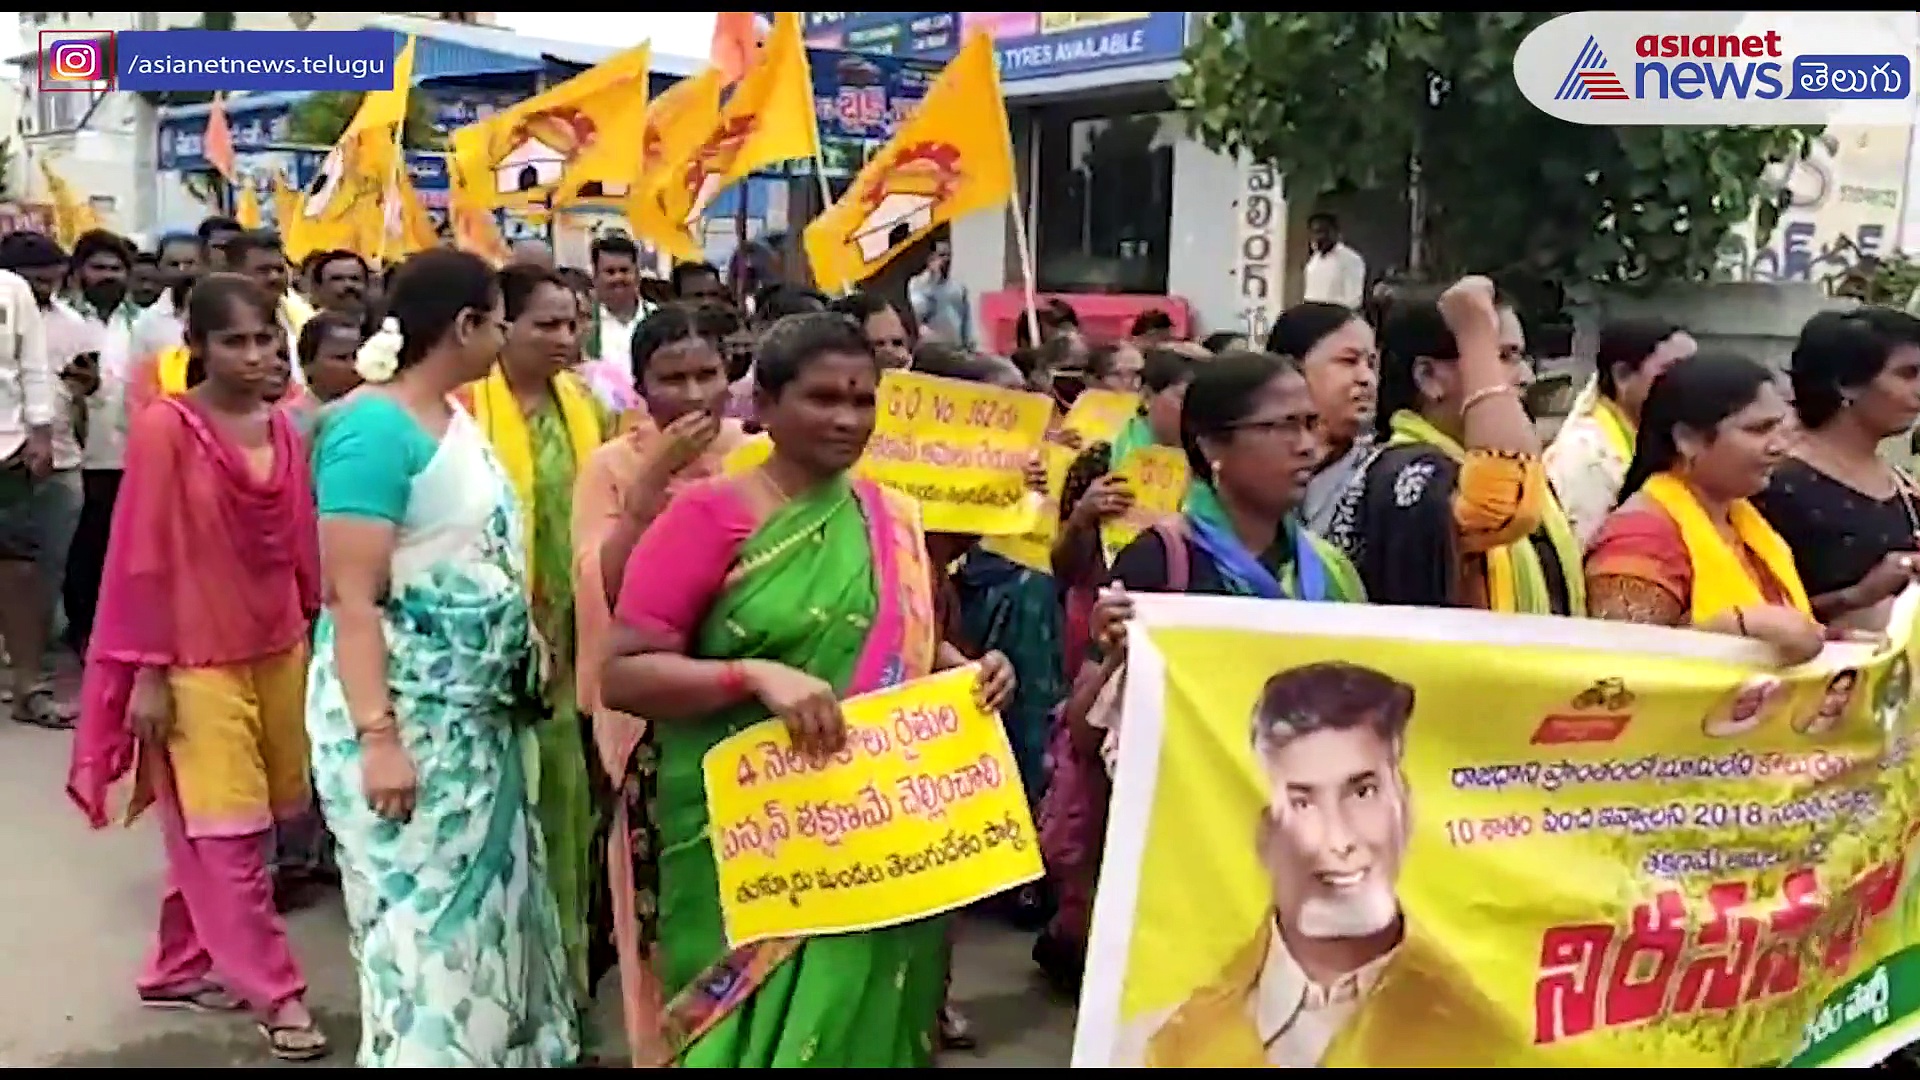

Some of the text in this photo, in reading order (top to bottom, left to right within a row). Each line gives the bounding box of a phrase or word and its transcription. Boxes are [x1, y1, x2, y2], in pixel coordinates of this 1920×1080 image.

[1006, 30, 1145, 69] TYRES AVAILABLE
[737, 753, 758, 788] 4
[1446, 817, 1474, 848] 10
[1693, 801, 1763, 828] 2018
